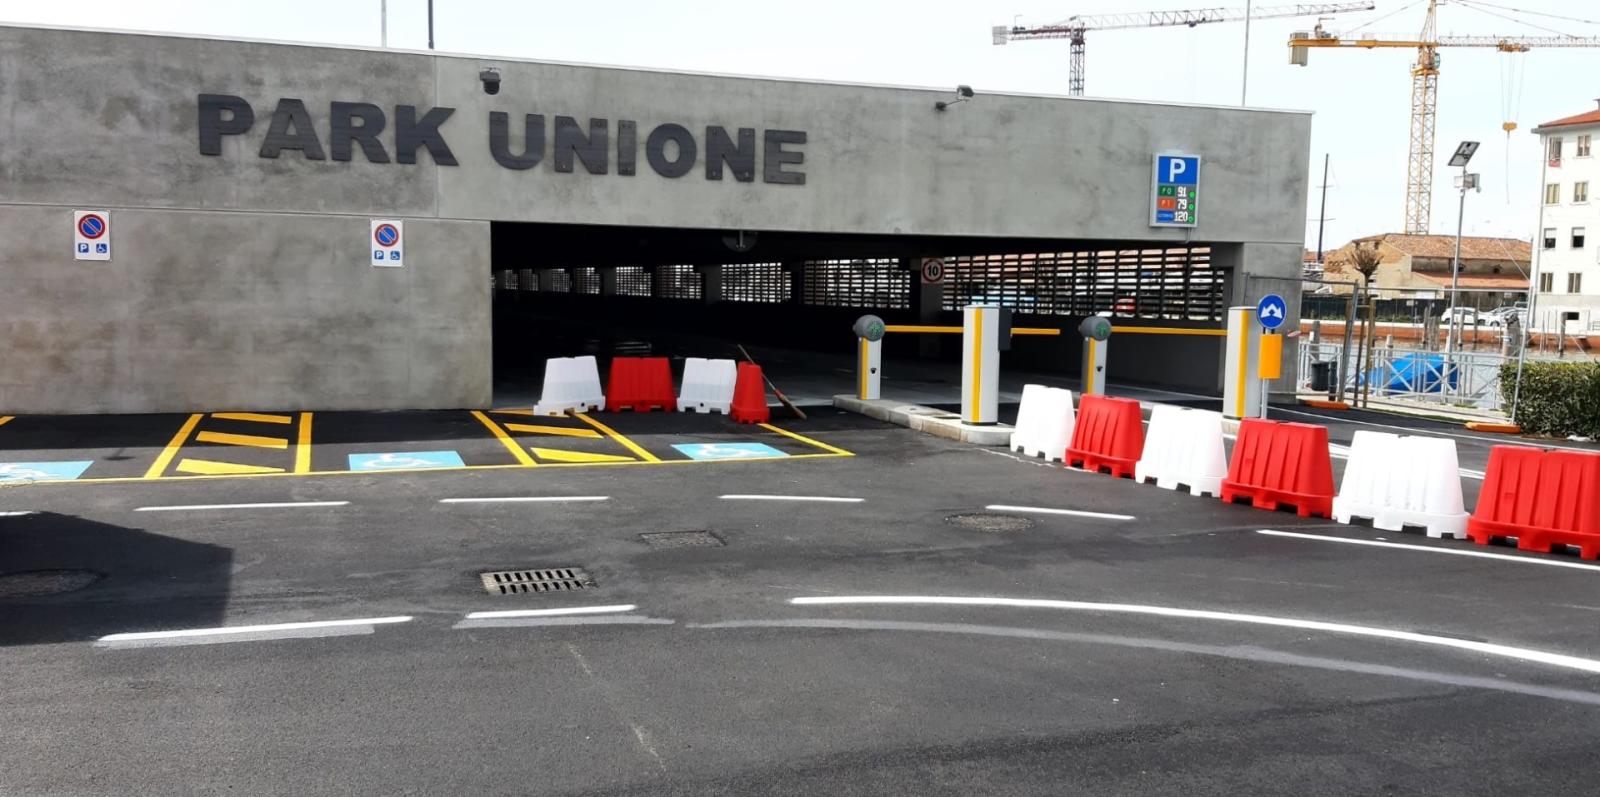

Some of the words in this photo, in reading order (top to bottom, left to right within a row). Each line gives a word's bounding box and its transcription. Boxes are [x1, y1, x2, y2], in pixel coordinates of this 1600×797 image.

[198, 93, 459, 167] PARK
[489, 111, 807, 185] UNIONE
[1169, 158, 1186, 183] P
[1177, 186, 1187, 198] 91
[1177, 199, 1187, 210] 79
[1174, 211, 1188, 222] 120
[80, 243, 88, 253] P
[376, 251, 383, 260] P
[927, 264, 938, 277] 10
